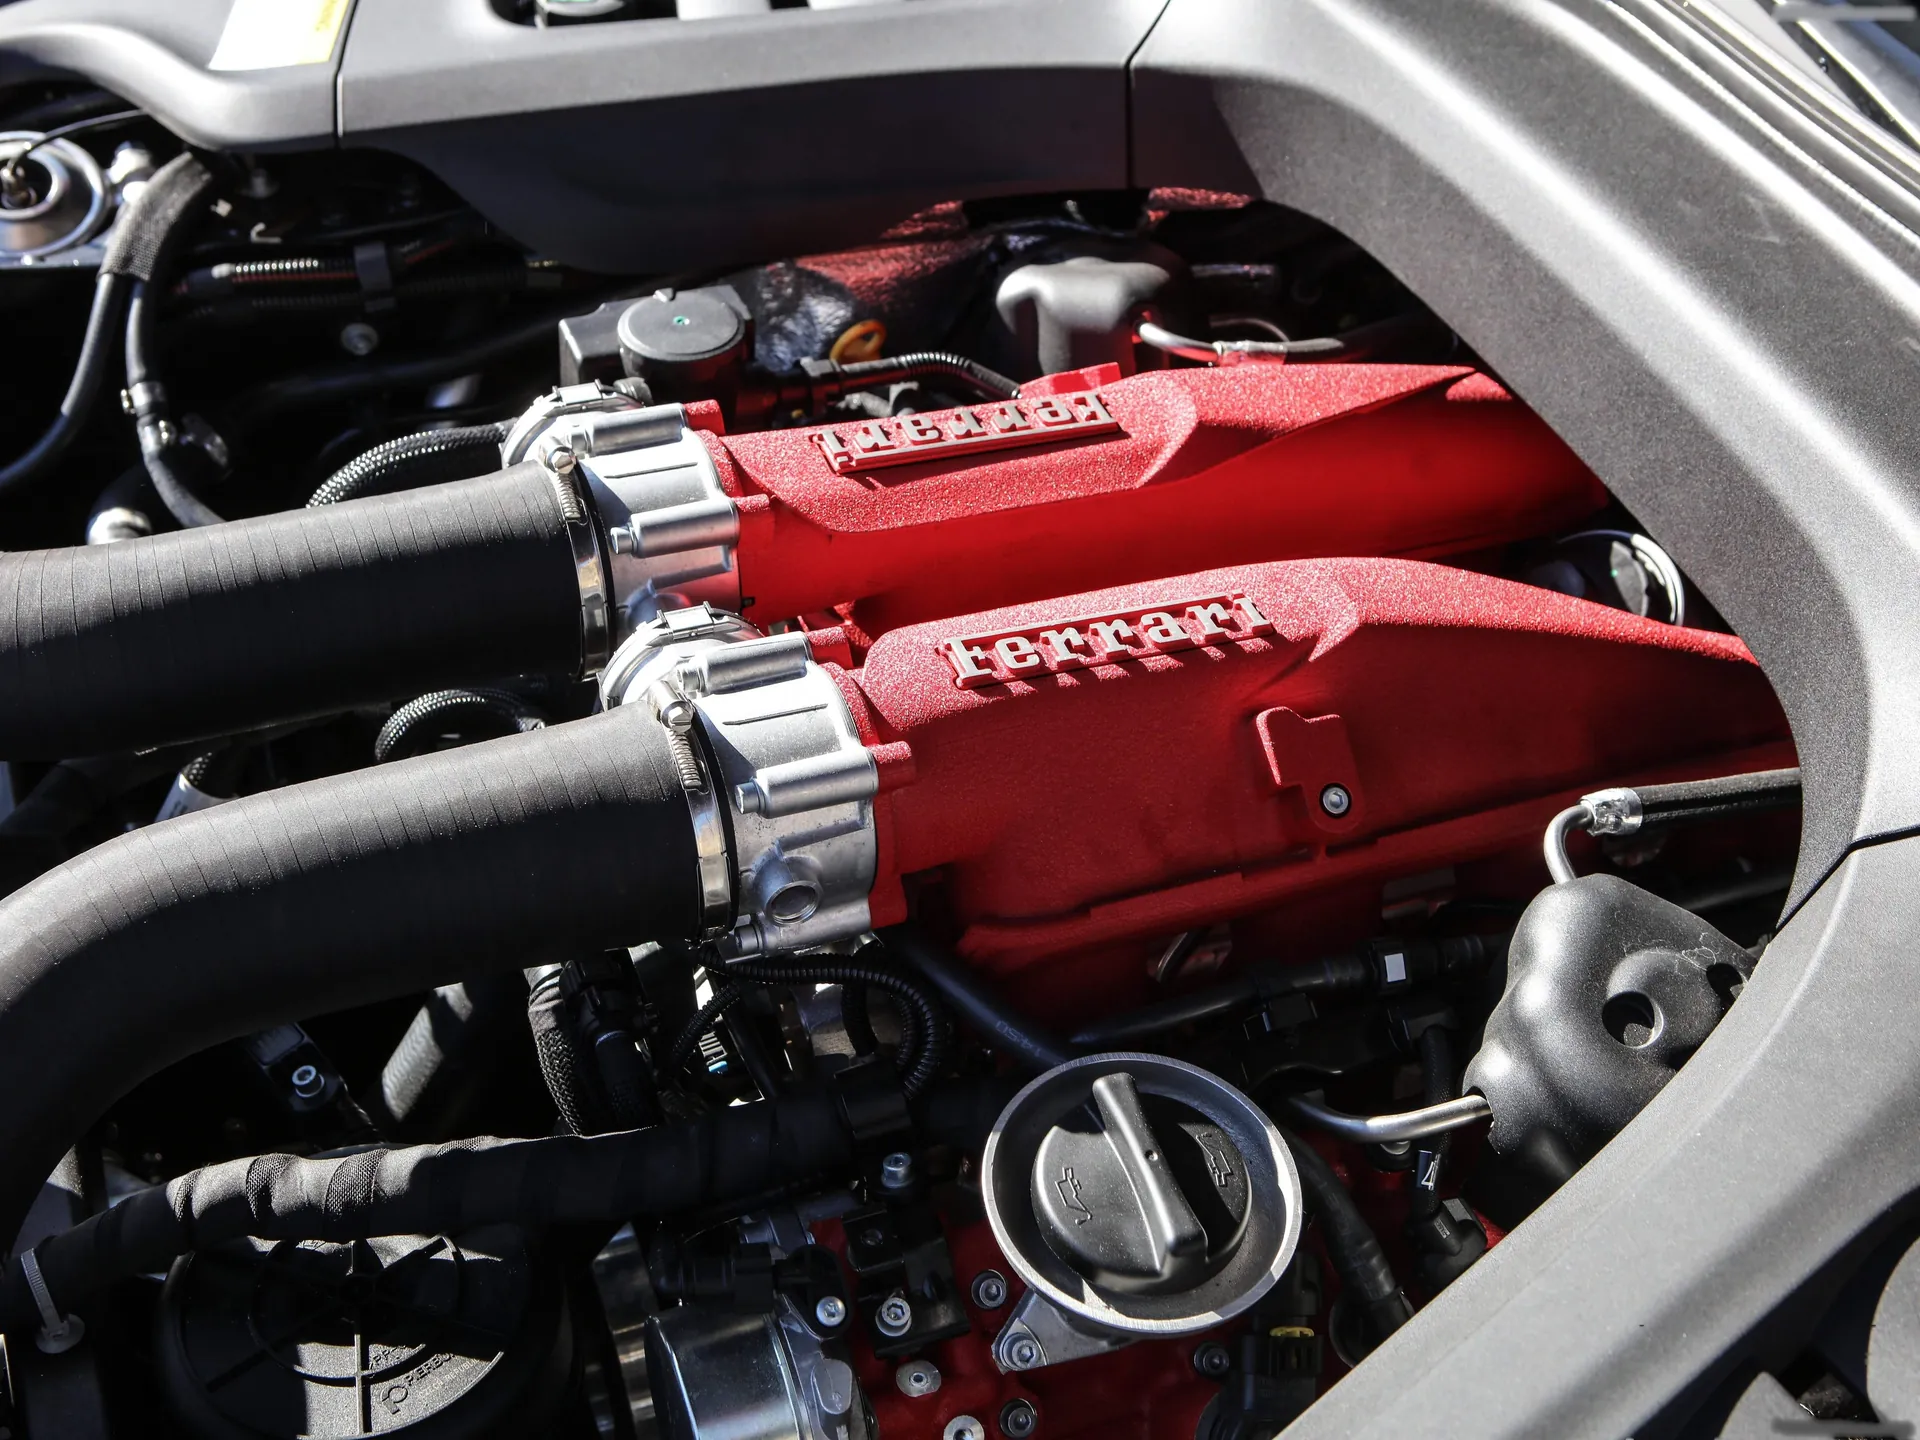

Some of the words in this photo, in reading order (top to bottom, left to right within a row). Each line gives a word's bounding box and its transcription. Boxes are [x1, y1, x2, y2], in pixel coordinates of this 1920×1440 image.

[811, 392, 1118, 470] Ferrari
[943, 588, 1273, 684] Ferrari
[402, 1352, 456, 1387] PIERBU
